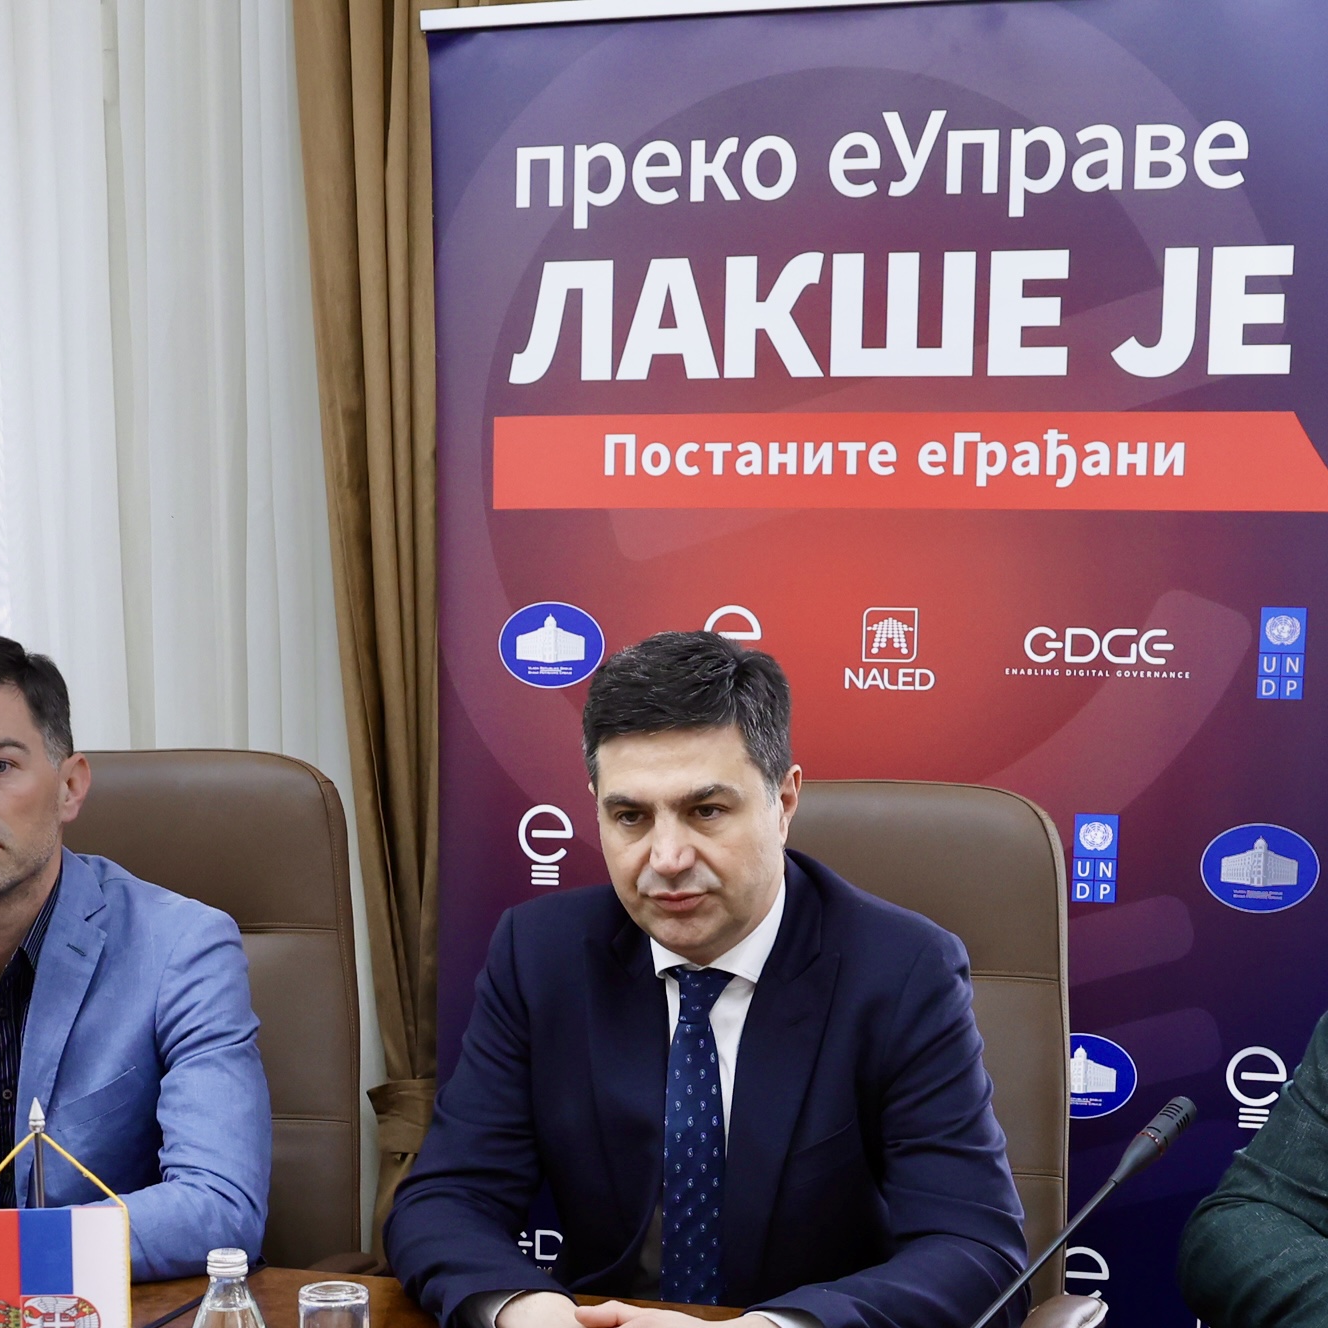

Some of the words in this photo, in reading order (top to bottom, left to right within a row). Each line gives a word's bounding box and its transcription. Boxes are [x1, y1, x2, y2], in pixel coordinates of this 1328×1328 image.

[515, 134, 798, 229] преко
[828, 109, 1250, 218] еУправе
[508, 248, 1071, 385] ЛАКШЕ
[1109, 244, 1296, 379] ЈЕ
[602, 432, 898, 477] Постаните
[916, 427, 1187, 488] еГрађани
[1023, 626, 1175, 665] EDGE
[1004, 667, 1060, 677] ENABLING
[1065, 668, 1111, 678] DIGITAL
[1115, 669, 1191, 680] GOVERNANCE
[1263, 655, 1300, 674] UN
[844, 667, 936, 692] NALED
[1261, 678, 1298, 697] DP
[1076, 860, 1113, 879] UN
[1075, 882, 1112, 900] DP
